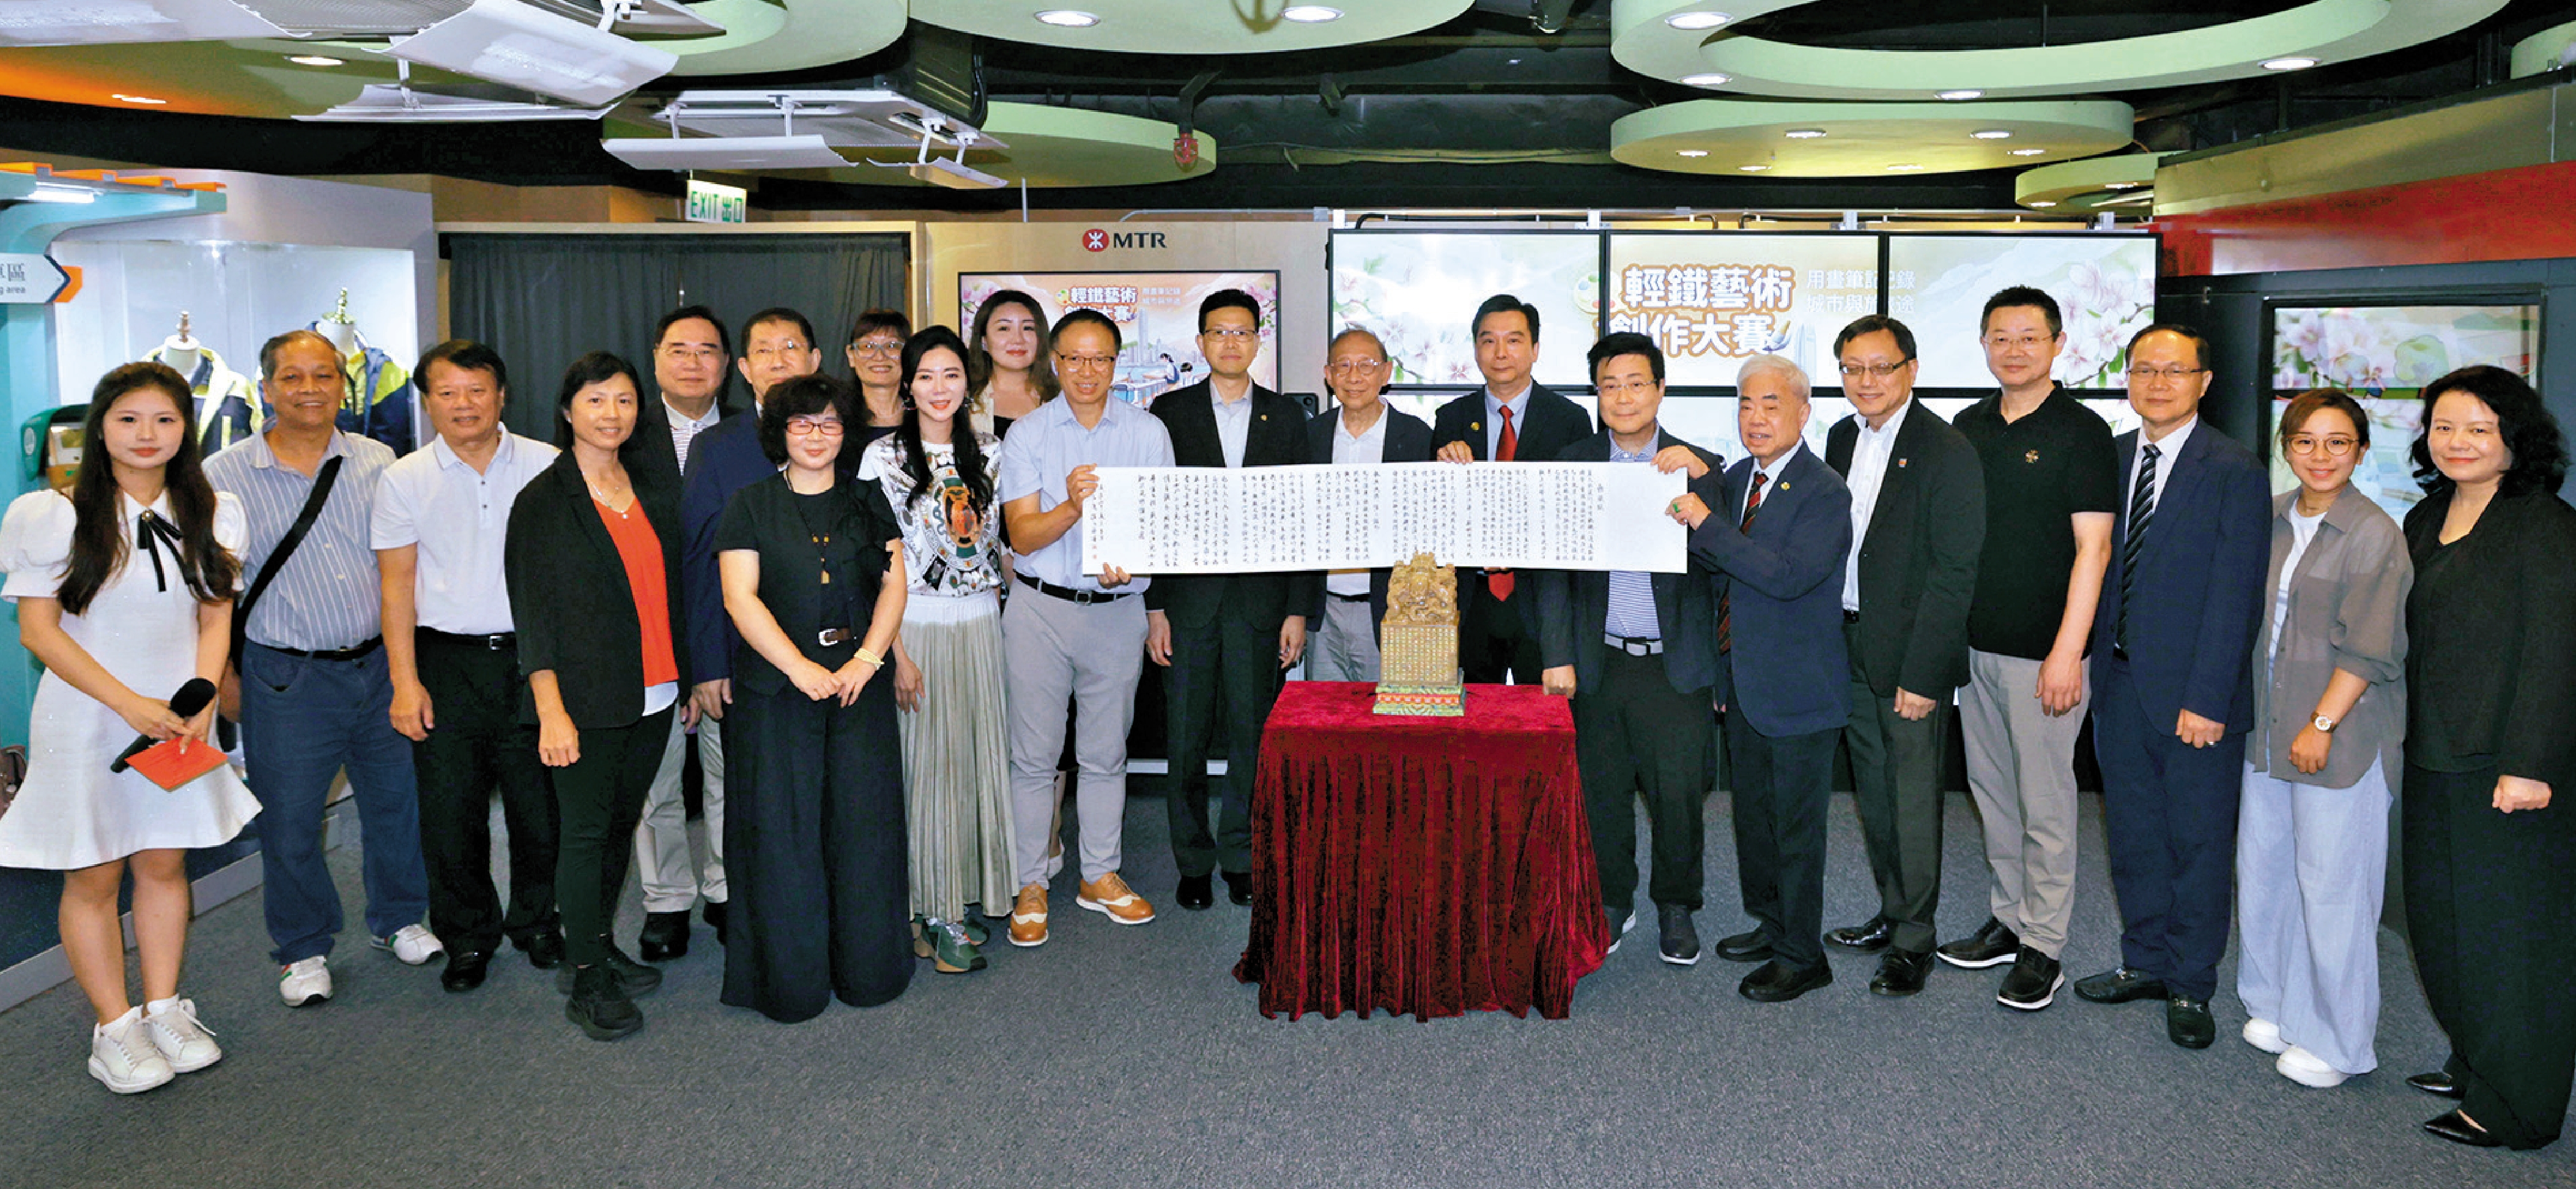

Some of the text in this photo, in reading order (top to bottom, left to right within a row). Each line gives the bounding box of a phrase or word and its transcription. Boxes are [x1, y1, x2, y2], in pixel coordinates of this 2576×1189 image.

[690, 191, 744, 223] EXIT 出口
[1113, 232, 1167, 248] MTR
[1623, 265, 1793, 308] 輕鐵藝術
